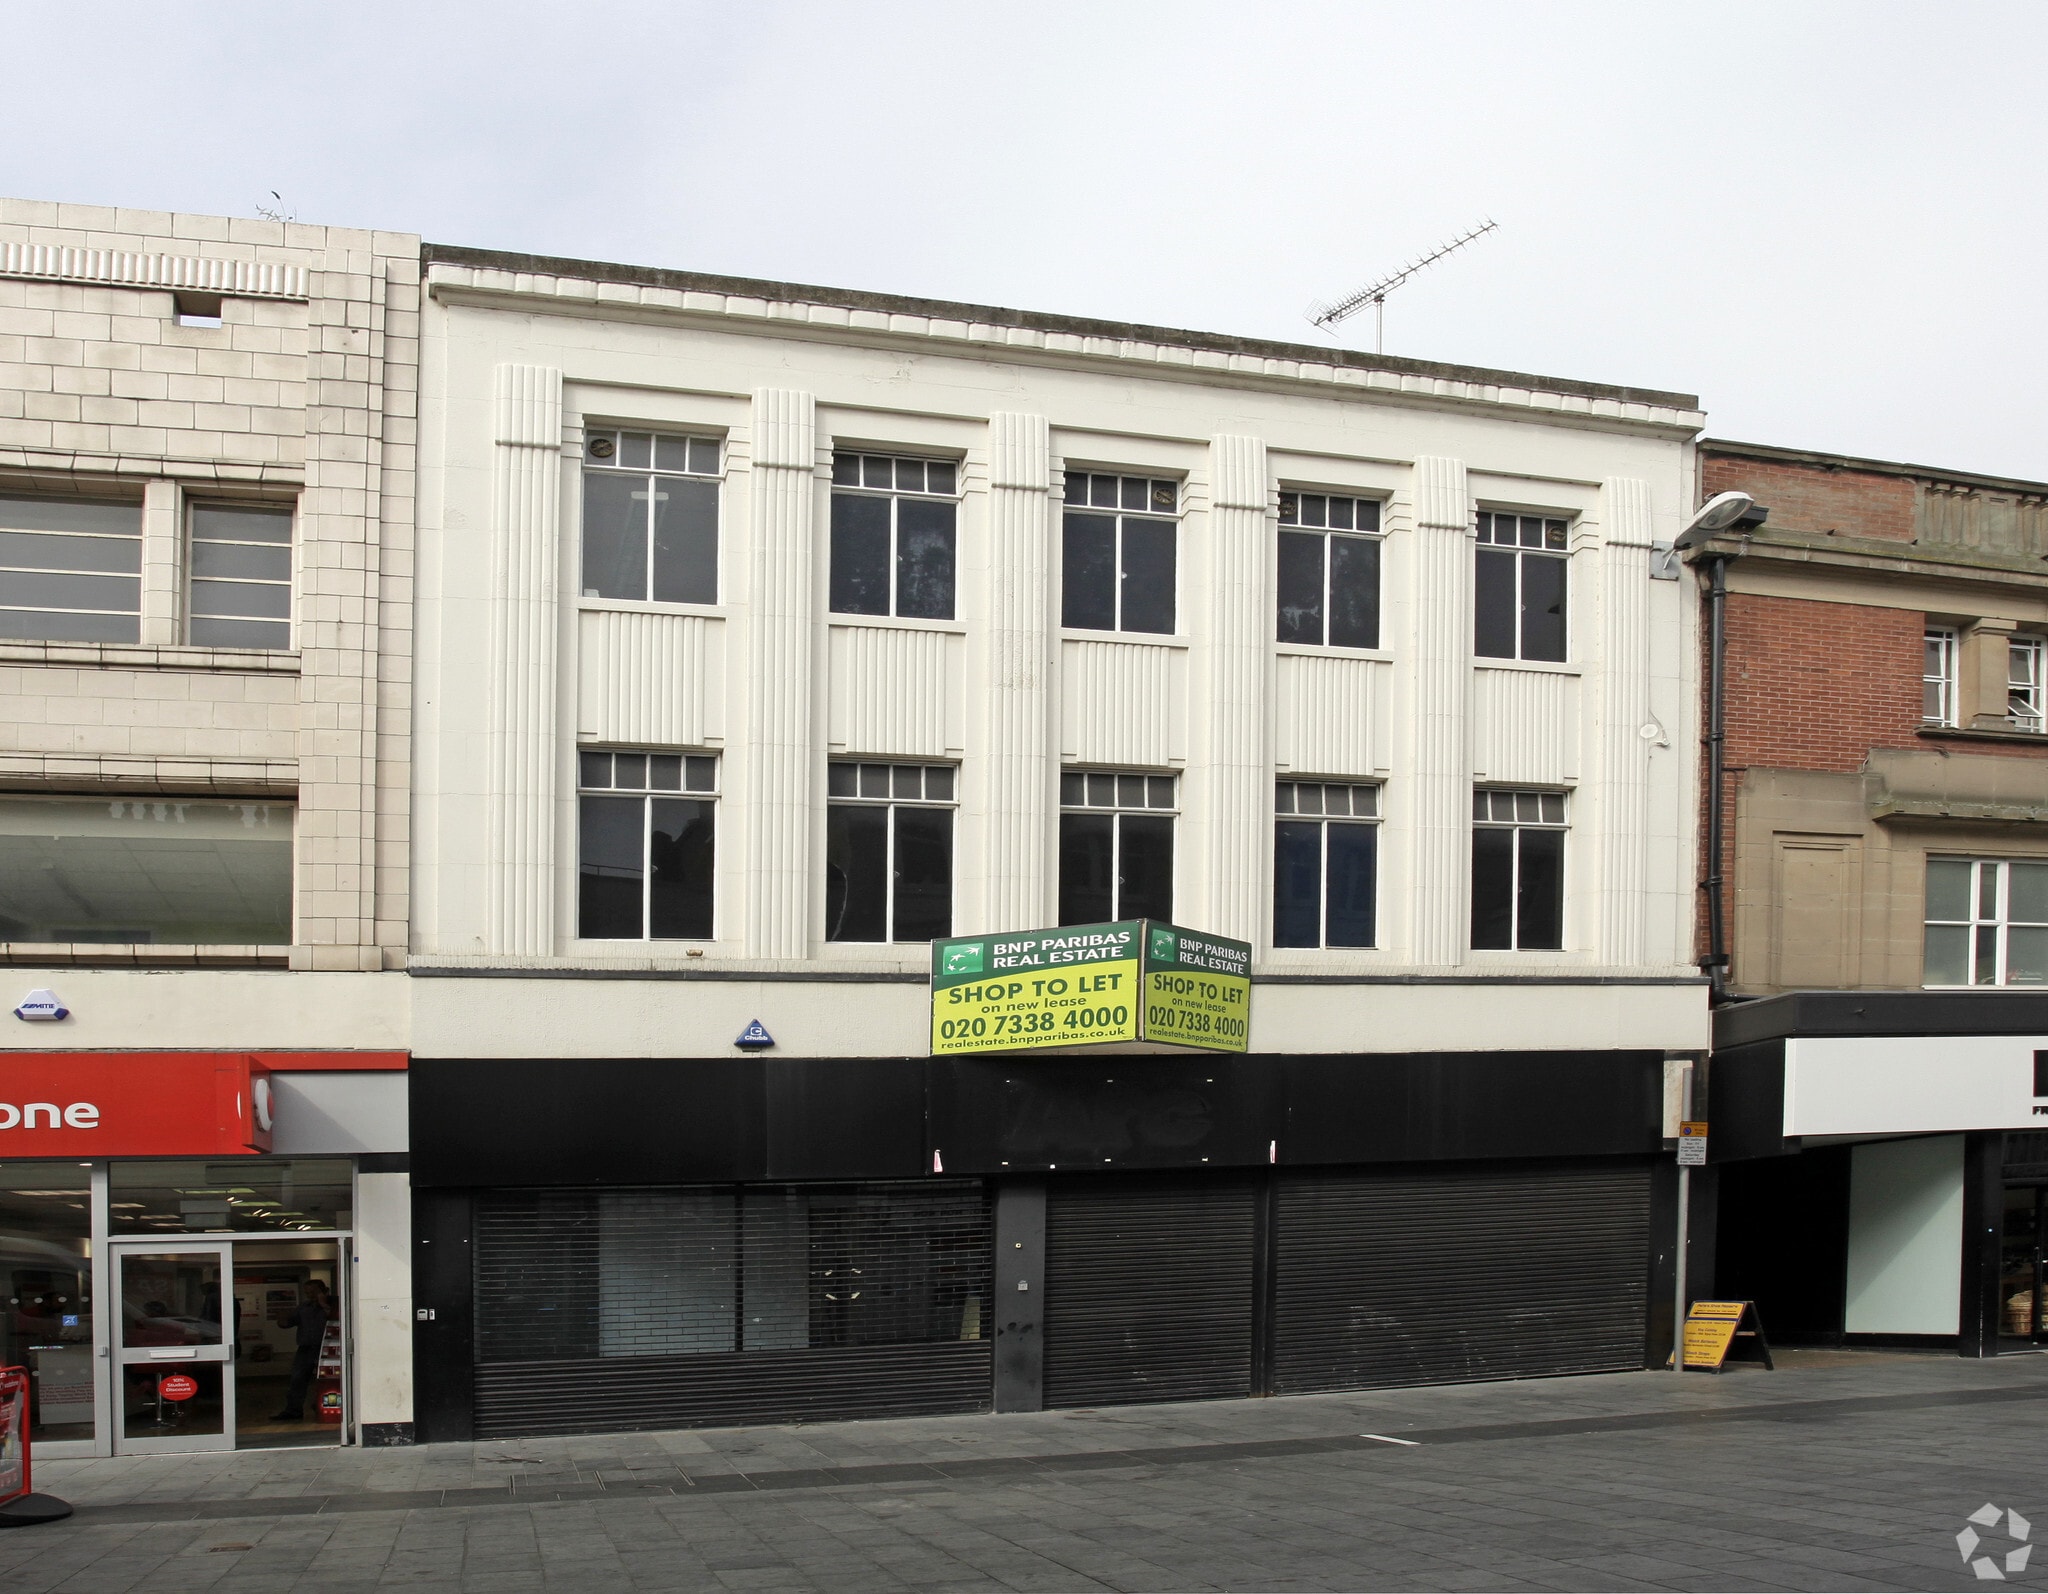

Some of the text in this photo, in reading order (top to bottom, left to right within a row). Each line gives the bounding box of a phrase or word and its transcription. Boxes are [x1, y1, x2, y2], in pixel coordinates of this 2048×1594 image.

[994, 932, 1130, 955] BNP PARIBAS
[1180, 938, 1248, 962] BNP PARIBAS
[993, 946, 1123, 968] REAL ESTATE
[1180, 952, 1244, 974] REAL ESTATE
[949, 973, 1122, 1004] SHOP TO LET
[1154, 974, 1243, 1004] SHOP TO LET
[981, 997, 1087, 1013] on new lease
[1172, 998, 1226, 1013] on new lease
[941, 1005, 1128, 1039] 020 7338 4000
[1150, 1005, 1244, 1038] 020 7338 4000
[941, 1027, 1126, 1048] realestate.bnpparibas.co.uk
[1149, 1028, 1243, 1047] realestate.bnpparibas.co.uk
[0, 1102, 100, 1129] one
